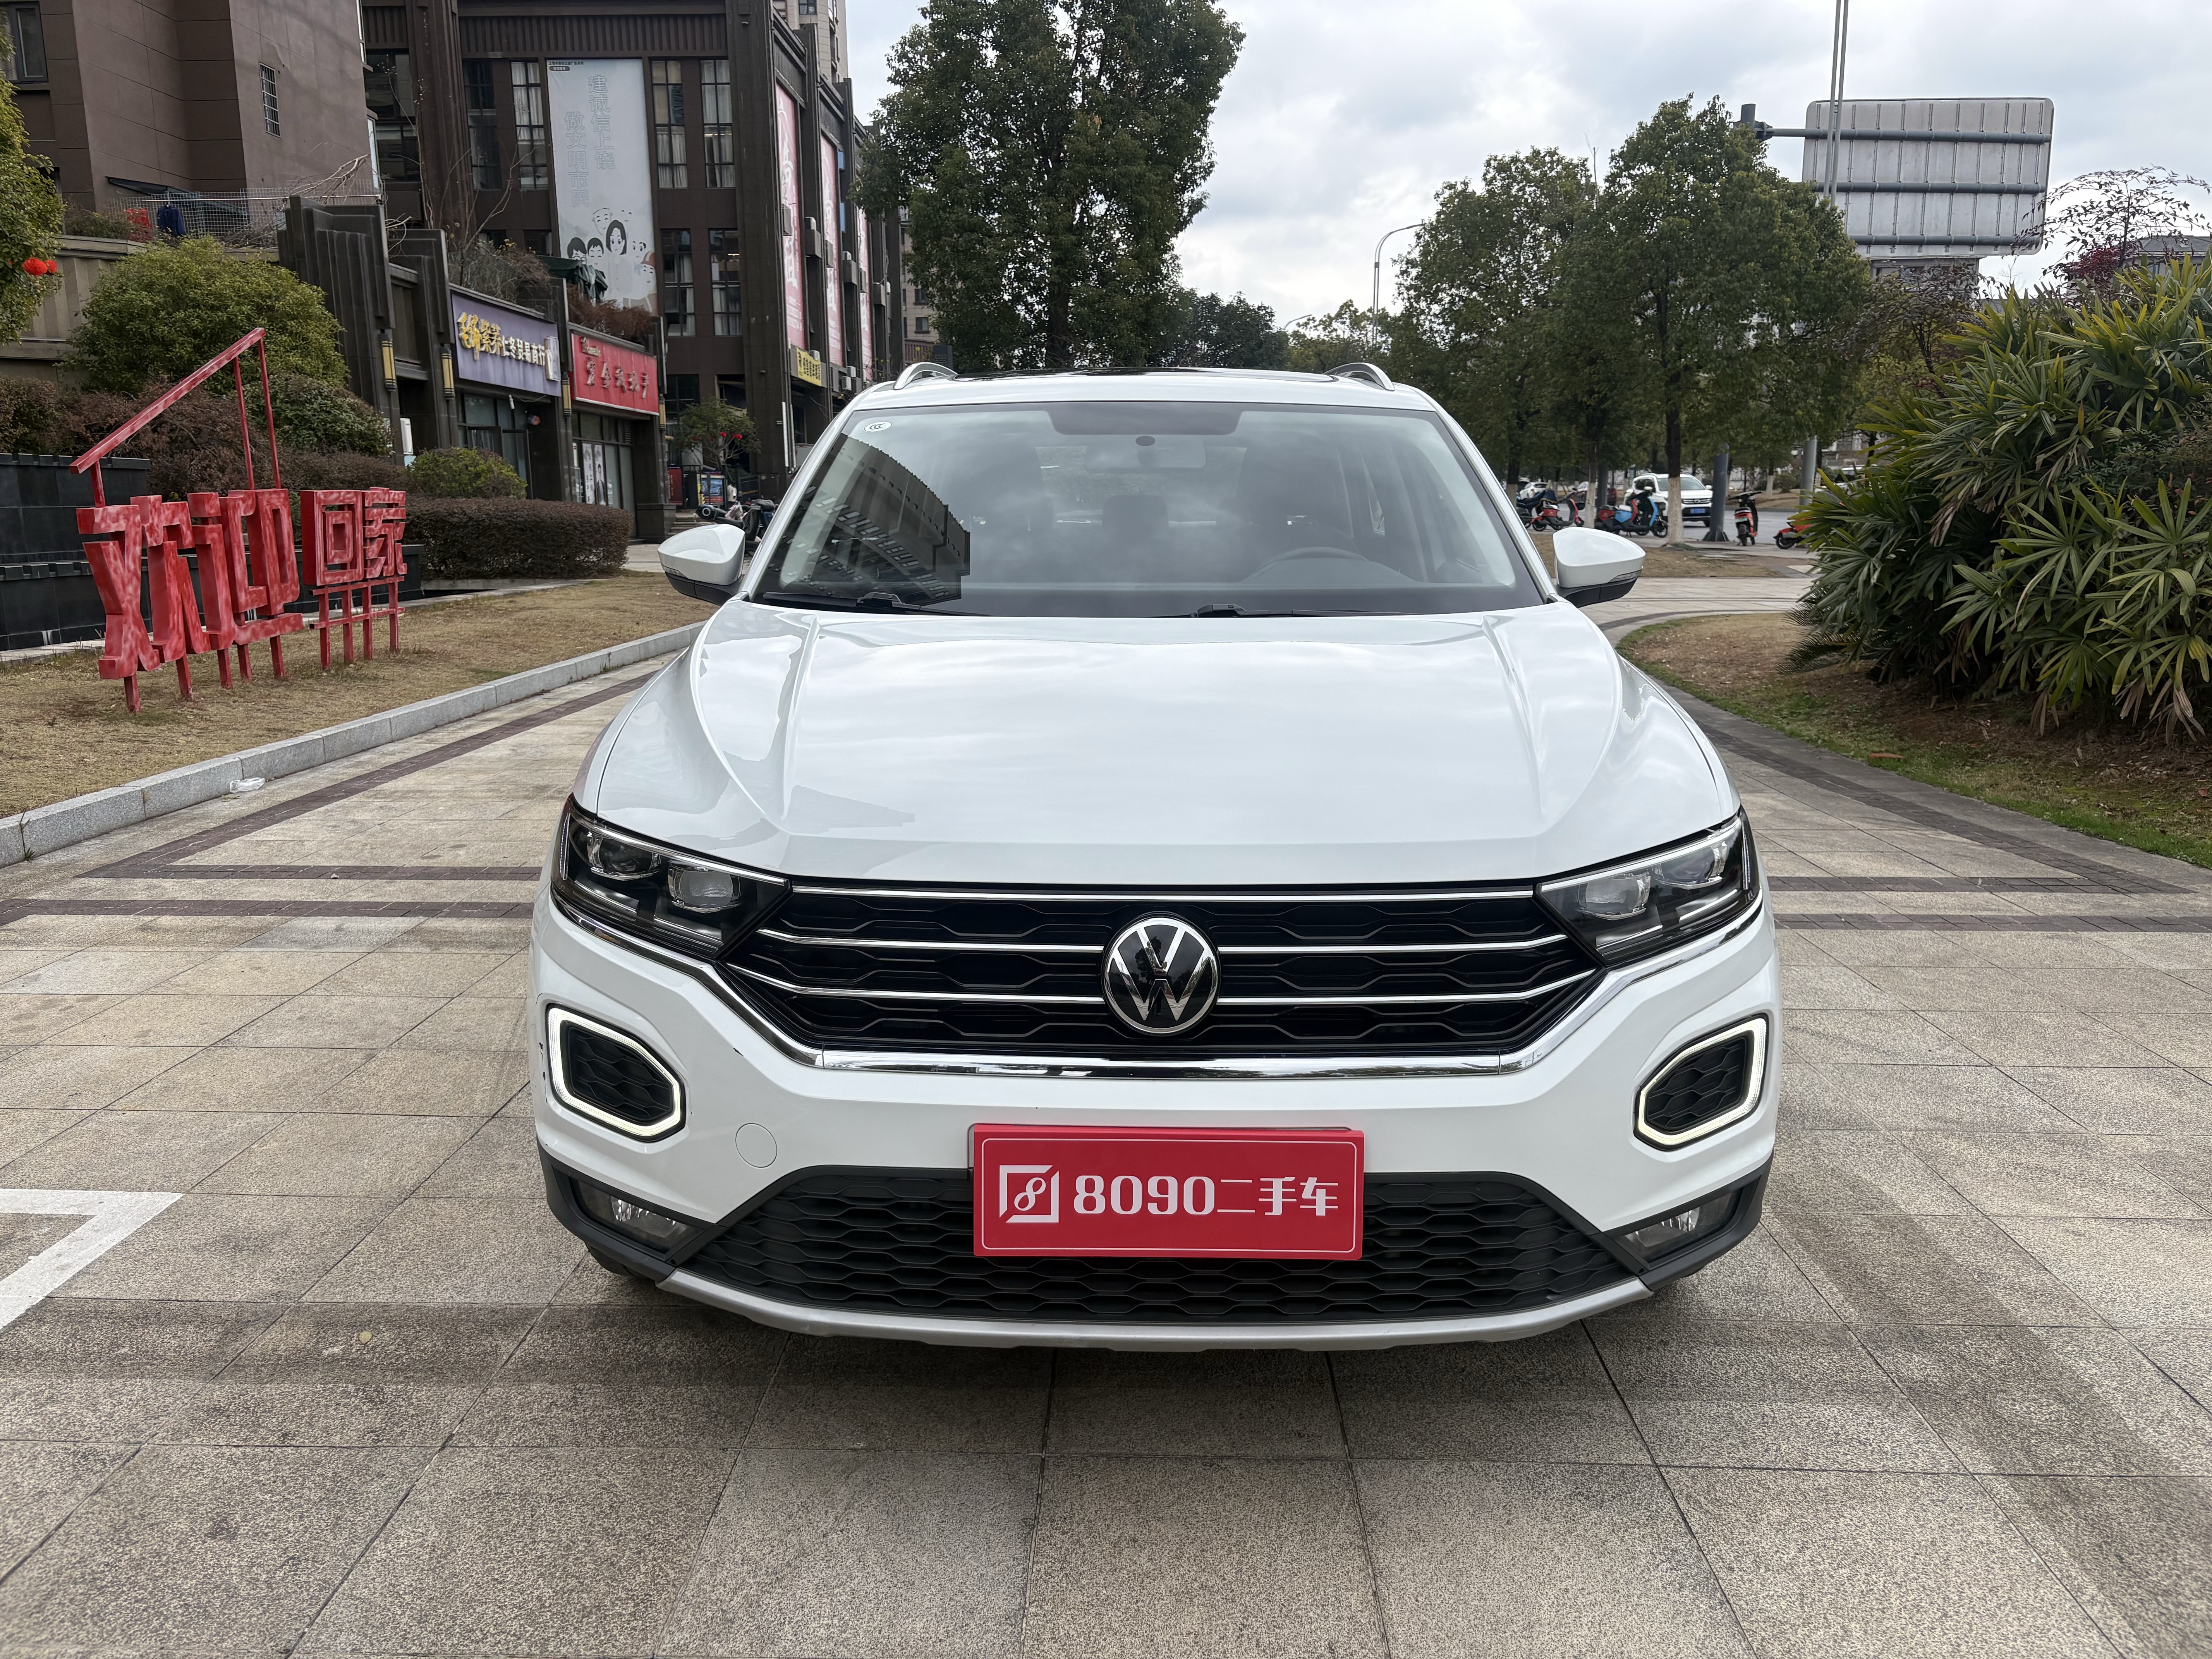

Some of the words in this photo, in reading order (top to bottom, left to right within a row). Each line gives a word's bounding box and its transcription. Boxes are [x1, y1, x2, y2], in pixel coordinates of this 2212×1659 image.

[564, 111, 591, 208] 做文明市民
[587, 75, 615, 169] 建诚信上饶
[76, 487, 407, 679] 欢迎回家
[1104, 917, 1218, 1033] VW
[1074, 1175, 1339, 1216] 8090二手车
